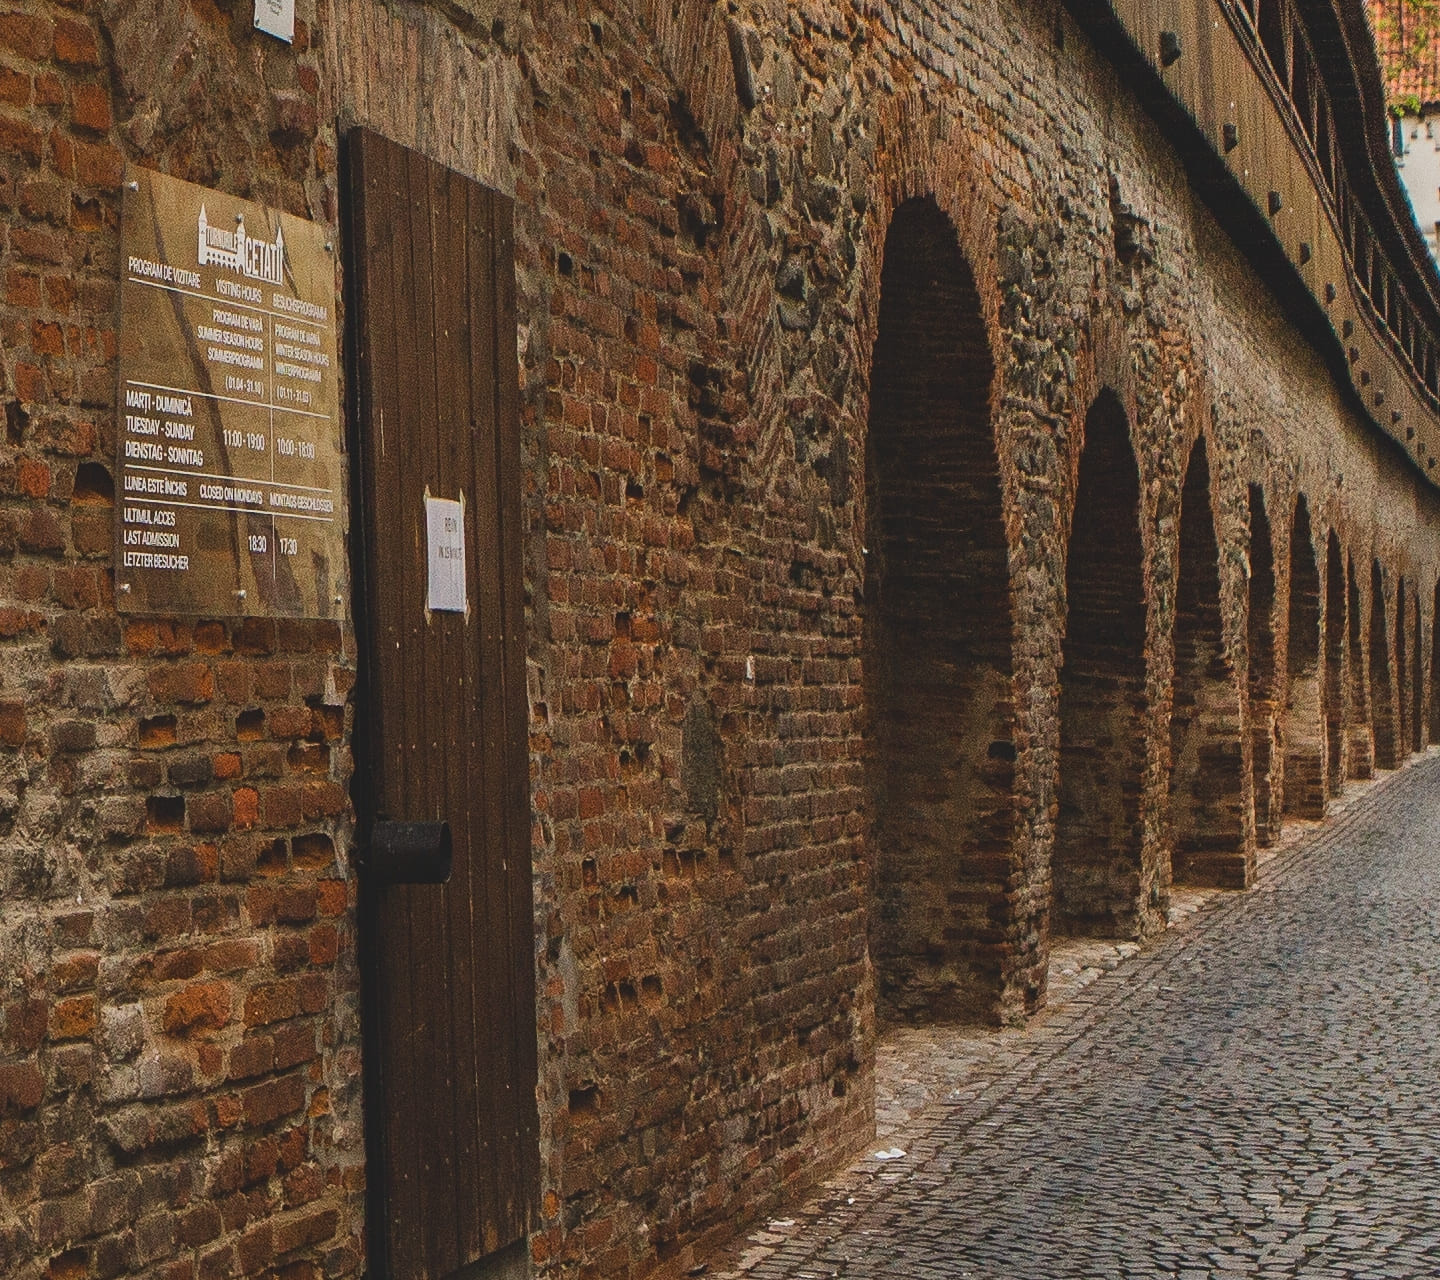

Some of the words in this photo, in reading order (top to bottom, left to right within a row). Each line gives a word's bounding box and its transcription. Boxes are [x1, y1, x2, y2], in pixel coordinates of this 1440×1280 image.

[128, 256, 163, 280] PROGRAM
[164, 265, 172, 282] DE
[173, 267, 200, 288] VIZITARE
[216, 279, 241, 299] VISITING
[242, 286, 262, 304] HOURS
[213, 309, 240, 328] PROGRAM
[197, 325, 222, 342] SUMMER
[223, 330, 245, 348] SEASON
[245, 336, 263, 352] HOURS
[275, 323, 299, 341] PROGRAM
[156, 396, 193, 417] DUMINICĂ
[126, 415, 160, 436] TUESDAY
[165, 421, 195, 441] SUNDAY
[223, 429, 242, 447] 11:00
[125, 440, 163, 461] DIENSTAG
[168, 446, 203, 466] SONNTAG
[124, 475, 147, 492] LUNEA
[147, 478, 164, 494] ESTE
[199, 484, 223, 501] CLOSED
[224, 486, 234, 501] ON
[234, 487, 263, 505] MONDAYS
[124, 507, 152, 525] ULTIMUL
[153, 510, 176, 527] ACCES
[124, 530, 142, 545] LAST
[143, 532, 180, 548] ADMISSION
[249, 535, 267, 553] 18:30
[280, 537, 298, 555] 17:30
[124, 551, 153, 568] LETZTER
[154, 554, 189, 570] BESUCHER
